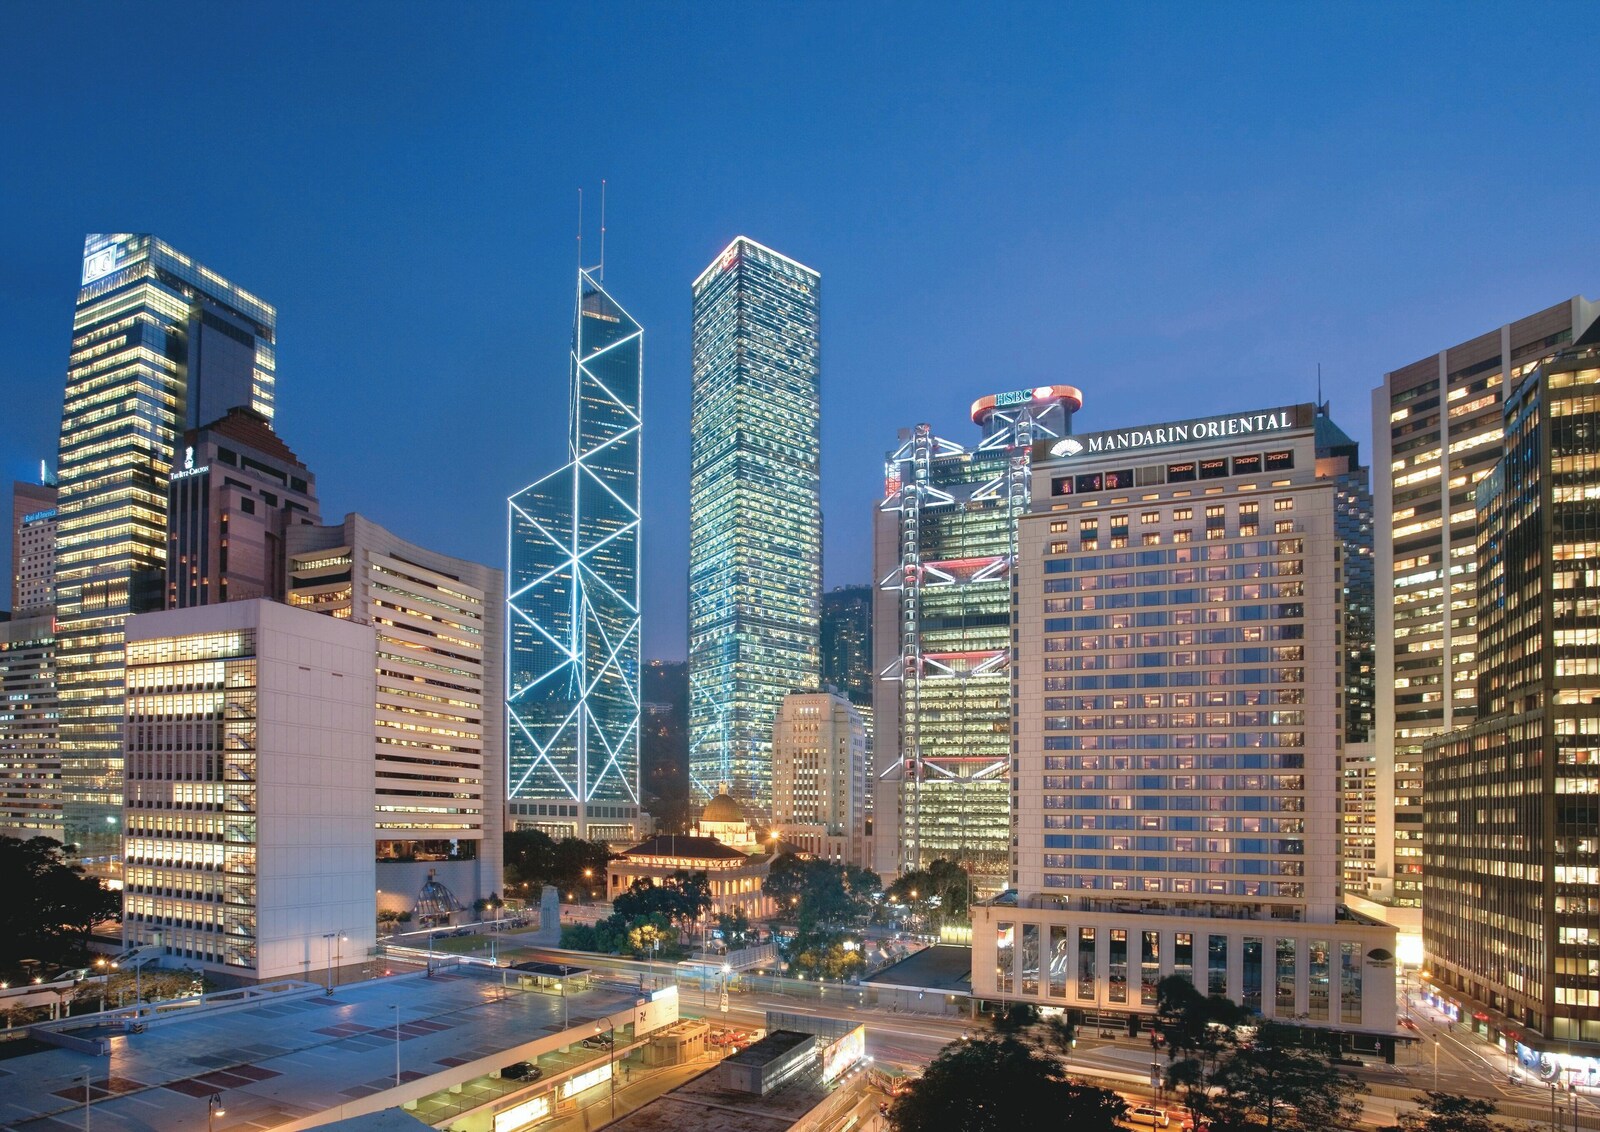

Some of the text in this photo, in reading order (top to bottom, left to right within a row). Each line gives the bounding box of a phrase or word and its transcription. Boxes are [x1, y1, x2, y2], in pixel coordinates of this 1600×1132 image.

[994, 389, 1033, 406] HSBC
[1088, 412, 1292, 452] MANDARIN ORIENTAL
